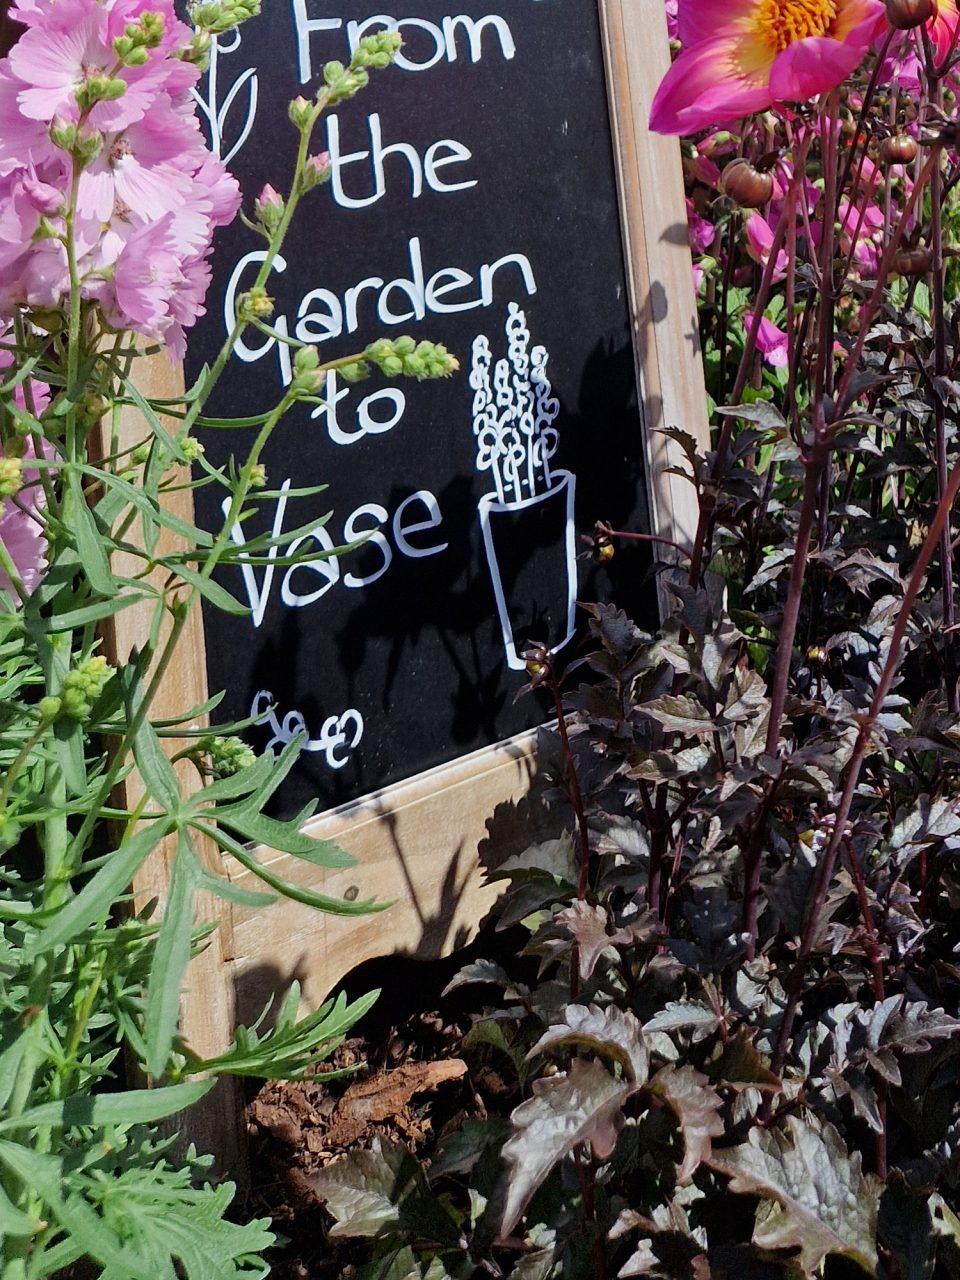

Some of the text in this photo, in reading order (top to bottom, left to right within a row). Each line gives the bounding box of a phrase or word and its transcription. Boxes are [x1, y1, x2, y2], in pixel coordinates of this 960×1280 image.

[325, 111, 479, 209] the
[224, 236, 538, 388] Garden
[310, 370, 407, 446] to
[220, 478, 449, 629] Vase
